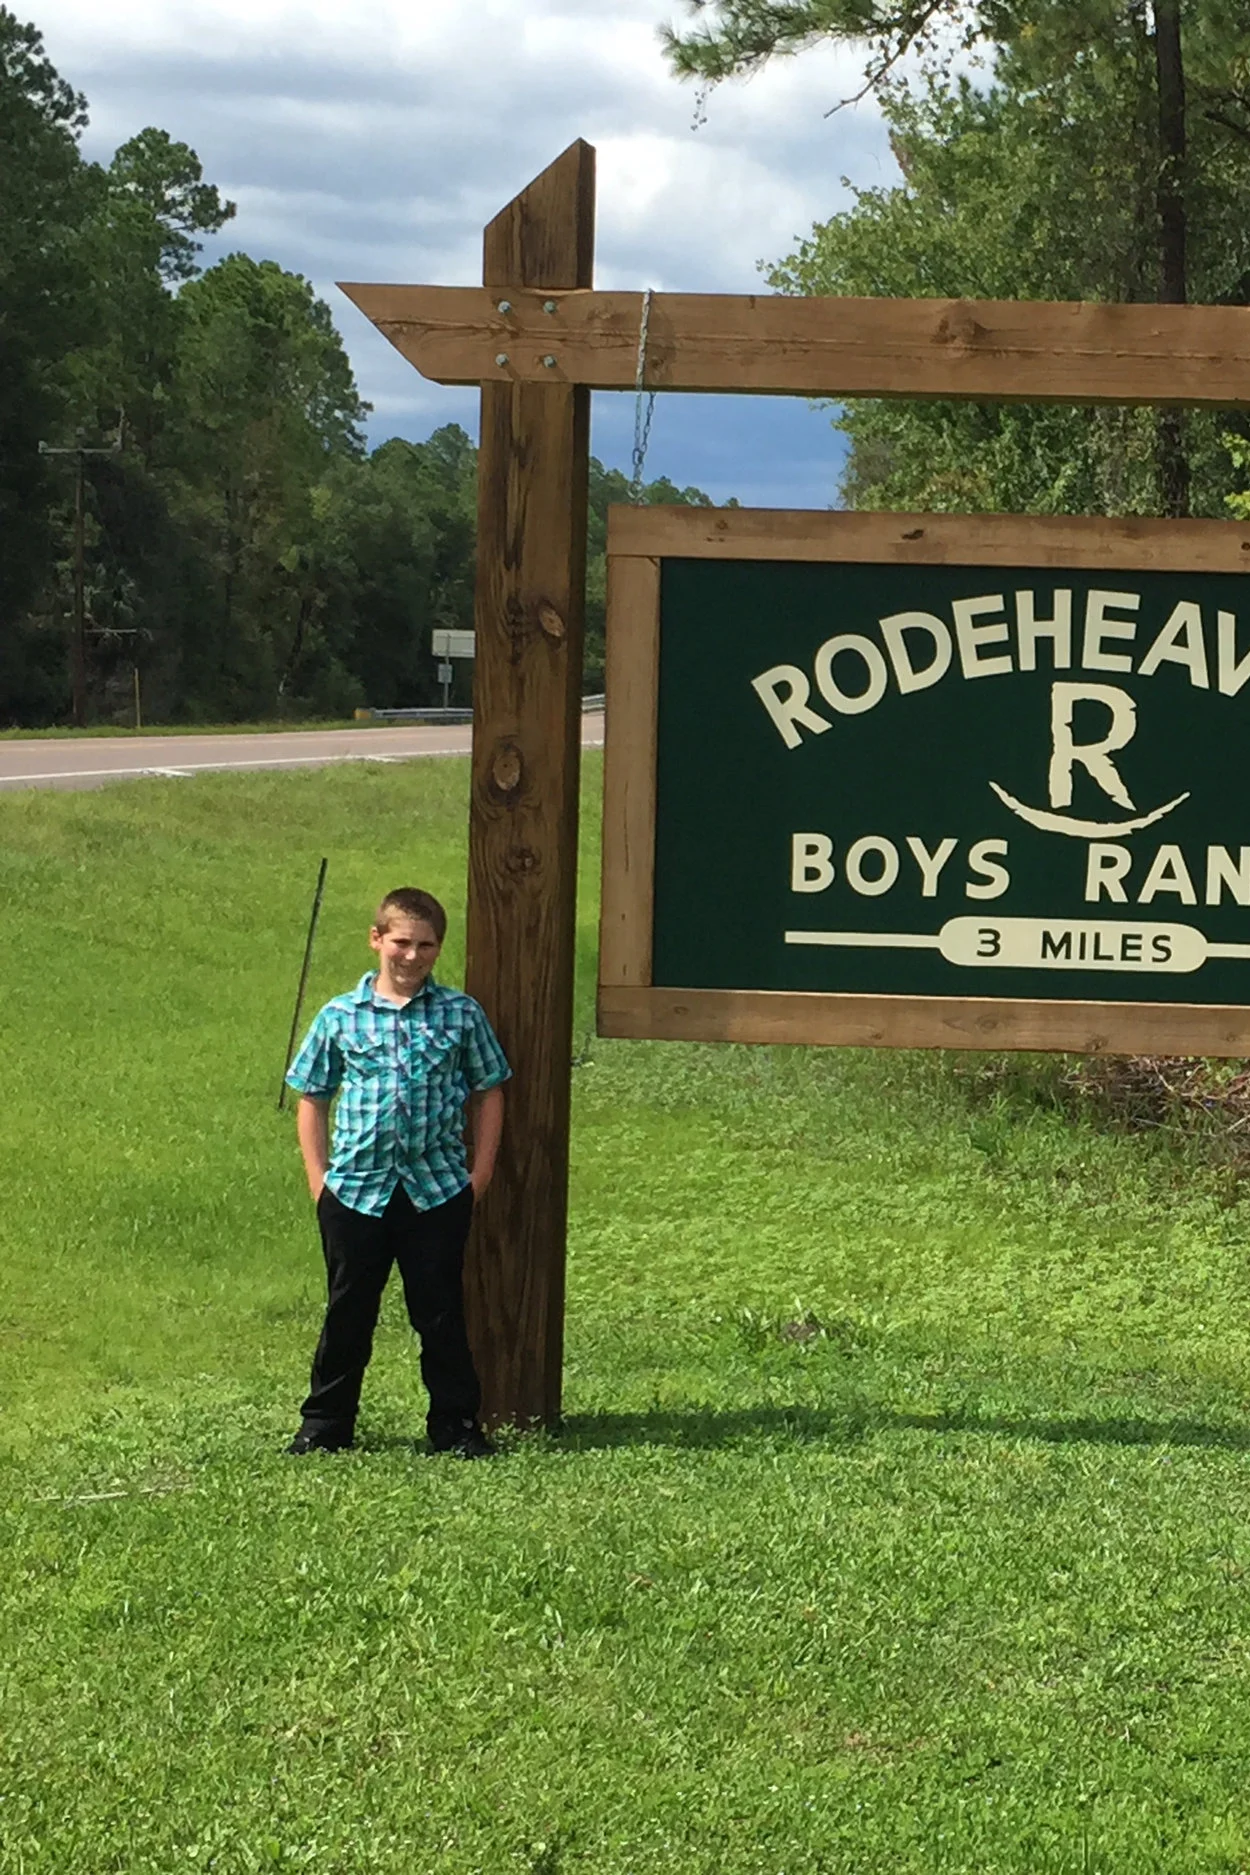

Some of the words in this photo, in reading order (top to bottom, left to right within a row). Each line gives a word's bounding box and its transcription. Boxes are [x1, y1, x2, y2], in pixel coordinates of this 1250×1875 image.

[1048, 681, 1137, 812] R
[791, 832, 1010, 900] BOYS
[976, 928, 1002, 958] 3
[1040, 930, 1173, 964] MILES
